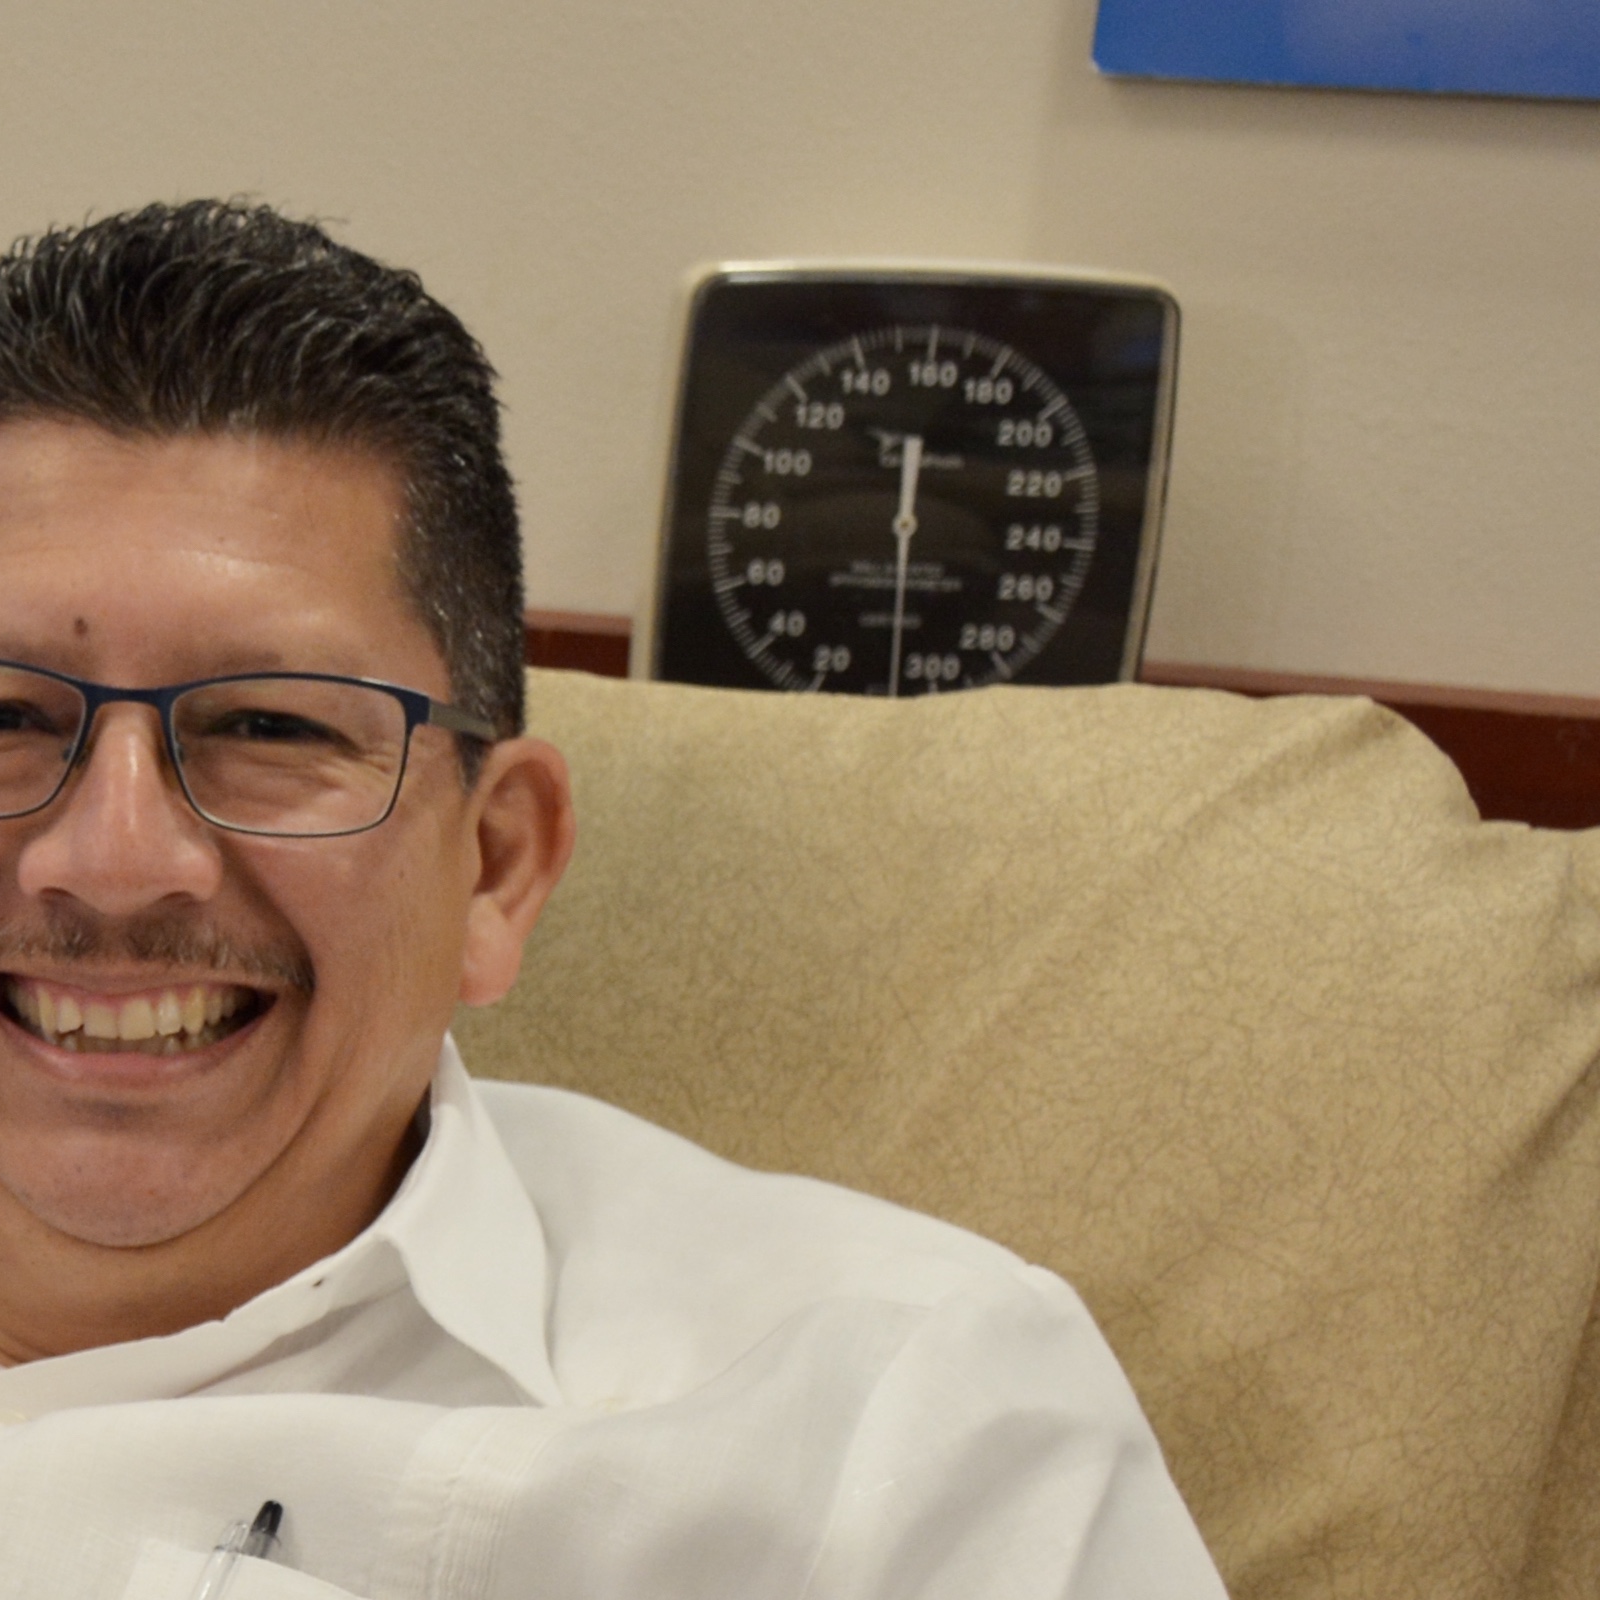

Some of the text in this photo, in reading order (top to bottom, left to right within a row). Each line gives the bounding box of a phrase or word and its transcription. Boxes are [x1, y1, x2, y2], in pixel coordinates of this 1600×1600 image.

[841, 368, 891, 396] 140
[909, 360, 958, 387] 160
[964, 377, 1013, 405] 180
[796, 402, 845, 430] 120
[998, 418, 1053, 448] 200
[764, 449, 812, 476] 100
[1007, 469, 1062, 498] 220
[743, 501, 781, 529] 80
[1006, 524, 1062, 553] 240
[747, 558, 785, 587] 60
[999, 573, 1054, 602] 260
[770, 610, 806, 637] 40
[961, 623, 1015, 652] 280
[814, 644, 851, 672] 20
[905, 652, 961, 680] 300
